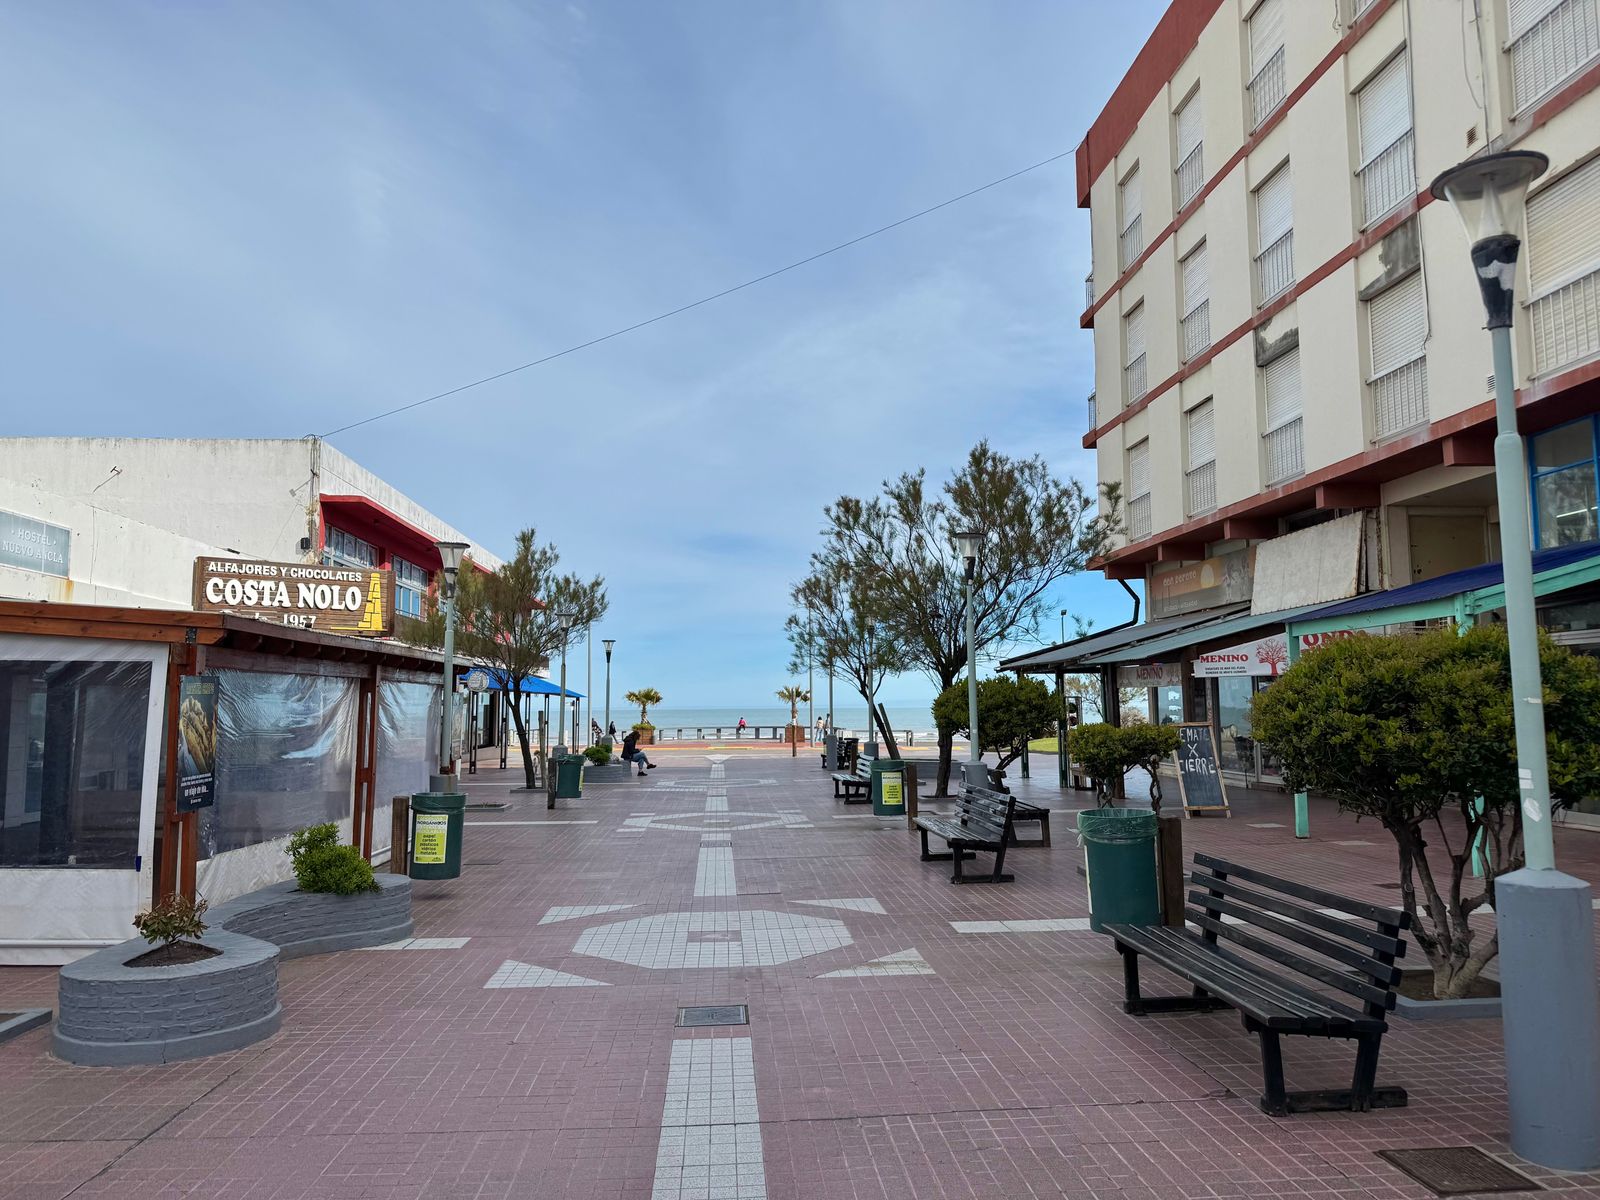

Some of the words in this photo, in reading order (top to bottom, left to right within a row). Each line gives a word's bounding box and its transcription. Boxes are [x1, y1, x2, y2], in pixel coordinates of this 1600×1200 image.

[18, 528, 51, 546] HOSTEL
[2, 540, 33, 557] NUEVO
[208, 561, 277, 576] ALFAJORES
[279, 567, 288, 577] Y
[290, 567, 362, 582] CHOCOLATES
[205, 577, 292, 608] COSTA
[297, 583, 362, 611] NOLO
[283, 613, 317, 628] 1957
[1200, 654, 1249, 664] MENINO
[1187, 743, 1198, 757] X
